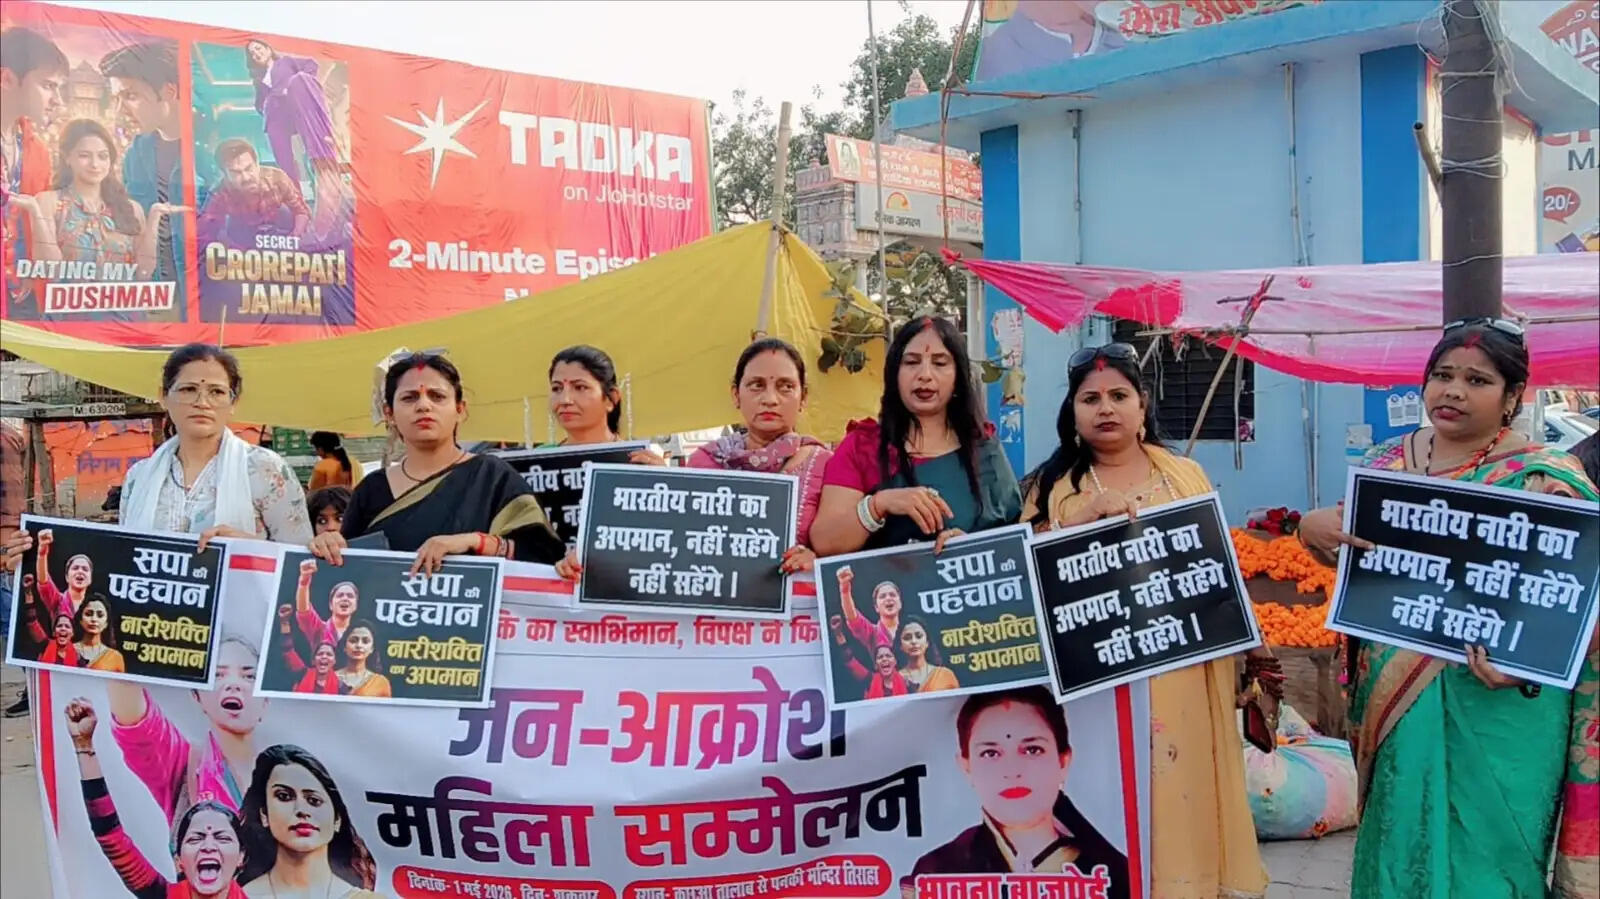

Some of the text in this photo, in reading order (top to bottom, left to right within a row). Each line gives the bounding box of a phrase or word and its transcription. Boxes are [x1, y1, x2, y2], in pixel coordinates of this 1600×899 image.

[499, 109, 693, 184] TADKA
[1568, 147, 1599, 171] M
[563, 184, 694, 211] on JioHotstar
[1544, 194, 1575, 212] 20/-
[255, 234, 300, 250] SECRET
[388, 239, 545, 275] 2-Minute
[16, 260, 138, 280] DATING MY
[205, 242, 346, 286] CROREPATI
[50, 285, 171, 312] DUSHMAN
[238, 283, 322, 316] JAMAI
[613, 482, 769, 519] भारतीय नारी का
[594, 525, 678, 559] अपमान,
[686, 525, 728, 556] नहीं
[730, 527, 780, 559] सहेंगे
[1380, 498, 1580, 560] भारतीय नारी का
[133, 546, 208, 579] सपा की
[936, 550, 1016, 583] सपा की
[1056, 523, 1203, 583] भारतीय नारी का
[108, 572, 209, 608] पहचान
[401, 571, 480, 599] सपा की
[629, 563, 672, 595] नहीं
[673, 565, 723, 598] सहेंगे
[918, 575, 1023, 614] पहचान
[1053, 558, 1228, 634] अपमान, नहीं सहेंगे
[1359, 544, 1585, 614] अपमान, नहीं सहेंगे
[120, 613, 210, 644] नारीशक्ति
[375, 598, 482, 627] पहचान
[1391, 595, 1444, 632] नहीं
[1442, 604, 1506, 648] सहेंगे
[526, 618, 557, 642] का
[563, 615, 683, 649] स्वाभिमान,
[693, 615, 754, 645] विपक्ष
[940, 614, 1036, 648] नारीशक्ति
[1093, 625, 1135, 667] नहीं
[1134, 614, 1188, 655] सहेंगे
[123, 640, 207, 669] का अपमान
[387, 636, 484, 662] नारीशक्ति
[950, 643, 1041, 672] का अपमान
[390, 665, 482, 687] का अपमान
[365, 776, 595, 868] महिला
[613, 764, 927, 867] सम्मेलन
[756, 874, 769, 894] से
